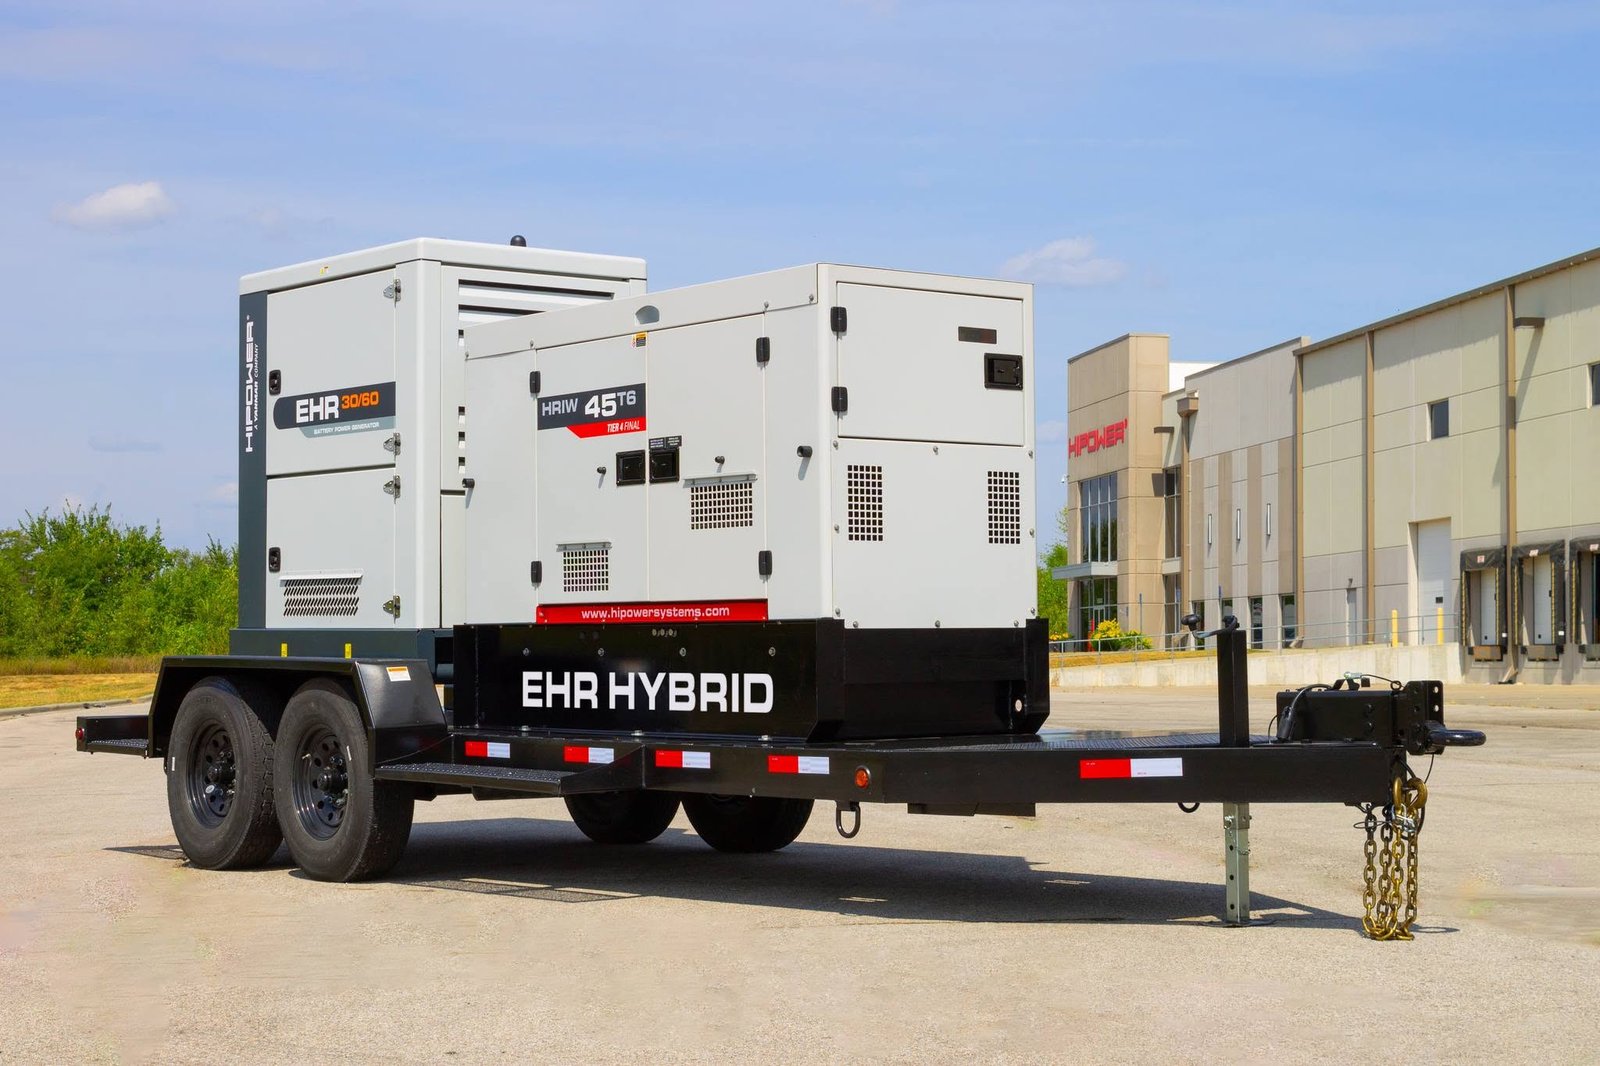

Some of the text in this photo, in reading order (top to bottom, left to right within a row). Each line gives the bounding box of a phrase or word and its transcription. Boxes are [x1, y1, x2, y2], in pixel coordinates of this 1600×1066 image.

[246, 321, 254, 452] HIPOWER
[296, 391, 379, 423] EHR 30/60
[542, 398, 578, 416] HRIW
[351, 421, 379, 431] GENERATOR
[607, 423, 619, 433] TIER
[624, 420, 640, 430] FINAL
[1068, 419, 1126, 459] HIPOWER
[581, 606, 730, 619] www.hipowersystems.com
[522, 671, 774, 713] EHR HYBRID
